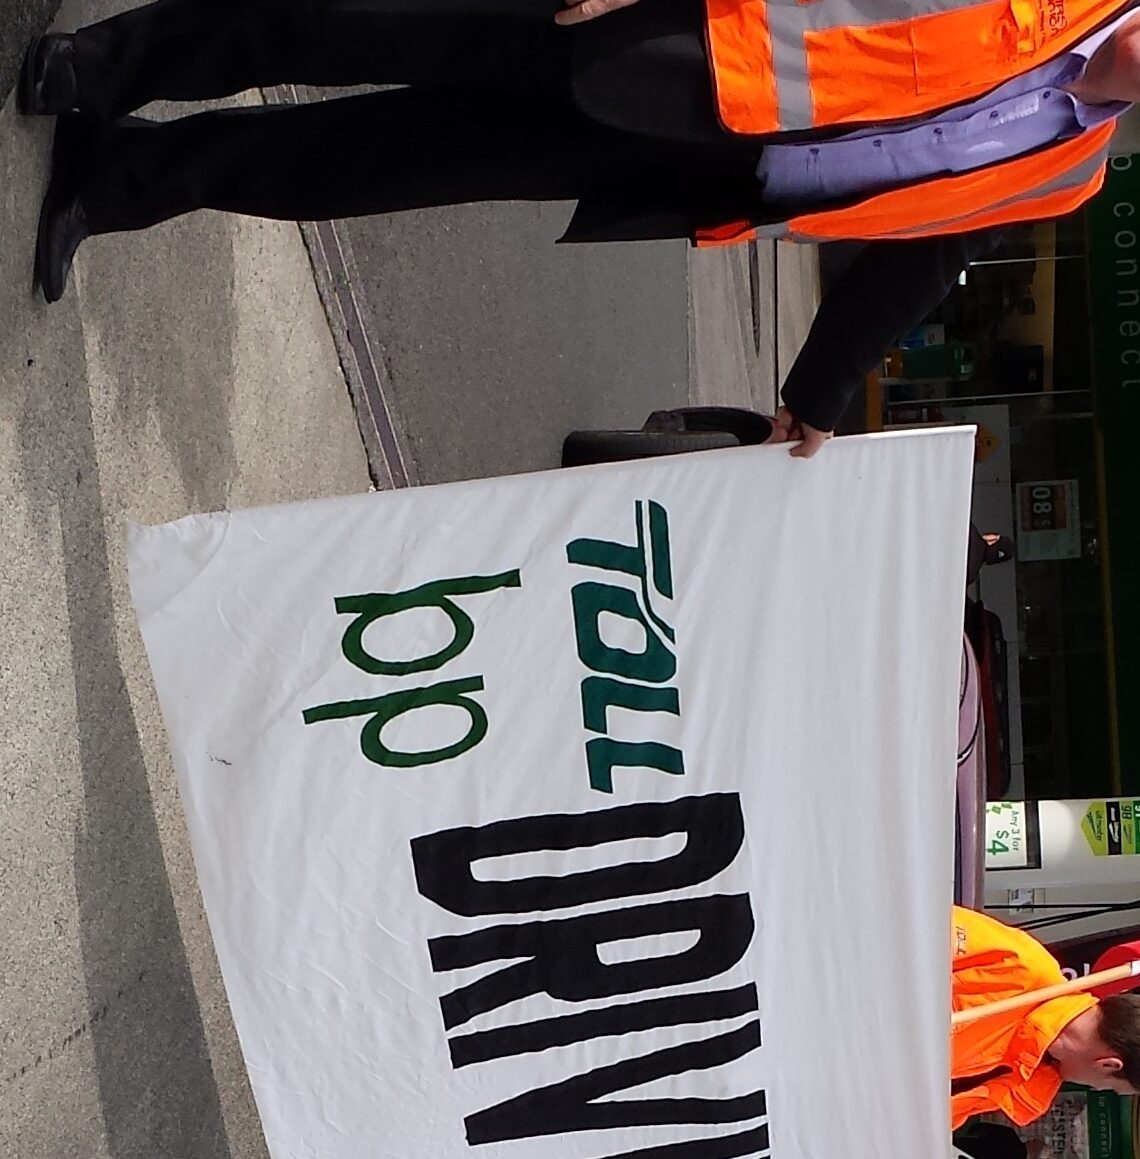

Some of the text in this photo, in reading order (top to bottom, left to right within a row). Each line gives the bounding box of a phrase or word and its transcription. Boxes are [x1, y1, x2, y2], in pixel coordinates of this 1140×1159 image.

[566, 499, 683, 794] TOLL
[302, 569, 522, 769] bp
[1010, 811, 1020, 826] Any
[1122, 805, 1132, 820] 98
[987, 830, 1010, 855] $4
[1012, 837, 1021, 851] for
